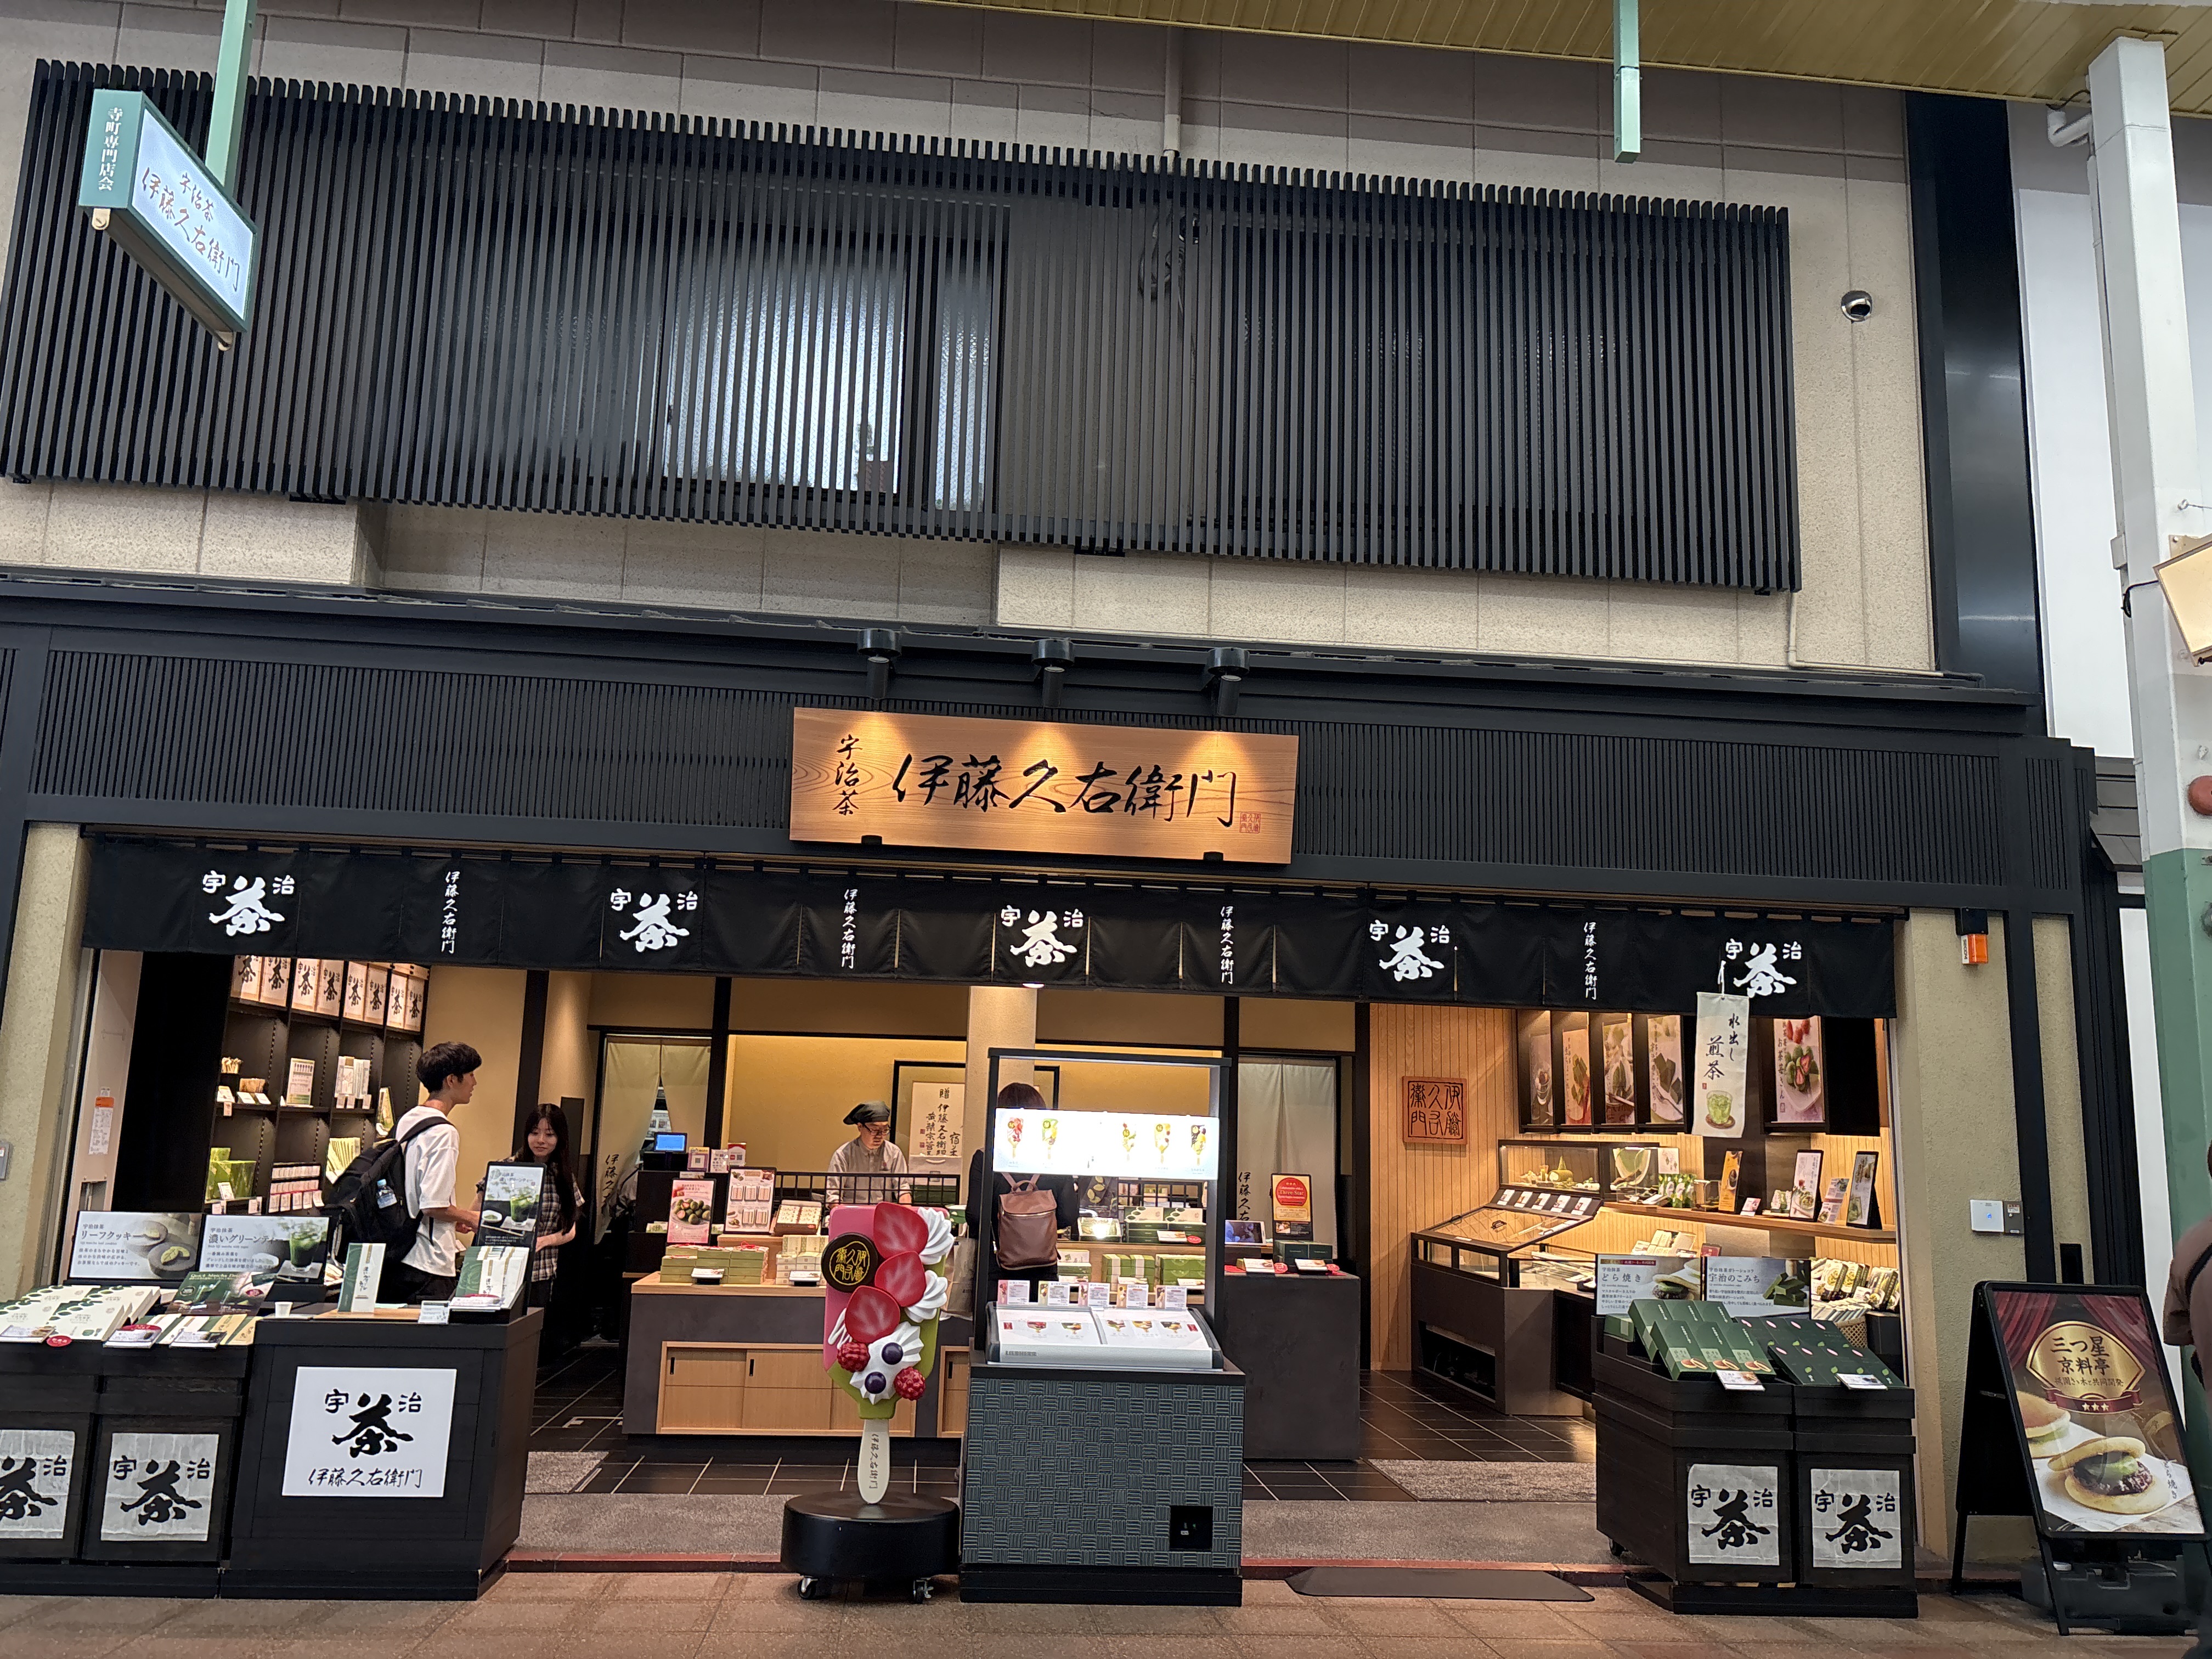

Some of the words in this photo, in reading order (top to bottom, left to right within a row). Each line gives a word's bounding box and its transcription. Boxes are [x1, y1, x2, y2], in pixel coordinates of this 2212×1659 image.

[98, 107, 123, 191] 寺町専門店会
[179, 172, 215, 222] 宇治茶
[142, 167, 240, 291] 伊藤久右衛門
[833, 734, 862, 816] 宇治茶
[892, 753, 1235, 827] 伊藤久右衛門
[441, 871, 460, 954] 伊藤久右衛門
[841, 889, 857, 969] 伊藤久右衛門
[1220, 906, 1234, 985] 伊藤久右衛門
[1583, 922, 1598, 1000] 伊藤久右衛門
[1703, 1035, 1725, 1080] 煎茶
[1728, 1013, 1740, 1061] 水出し
[82, 1231, 142, 1240] リーフクッキー
[1602, 1273, 1641, 1283] どら焼き
[1708, 1273, 1760, 1283] 宇治のこみち
[2051, 1335, 2110, 1357] 三つ星
[2057, 1357, 2111, 1375] 京料亭
[309, 1468, 422, 1488] 伊藤久右衛門
